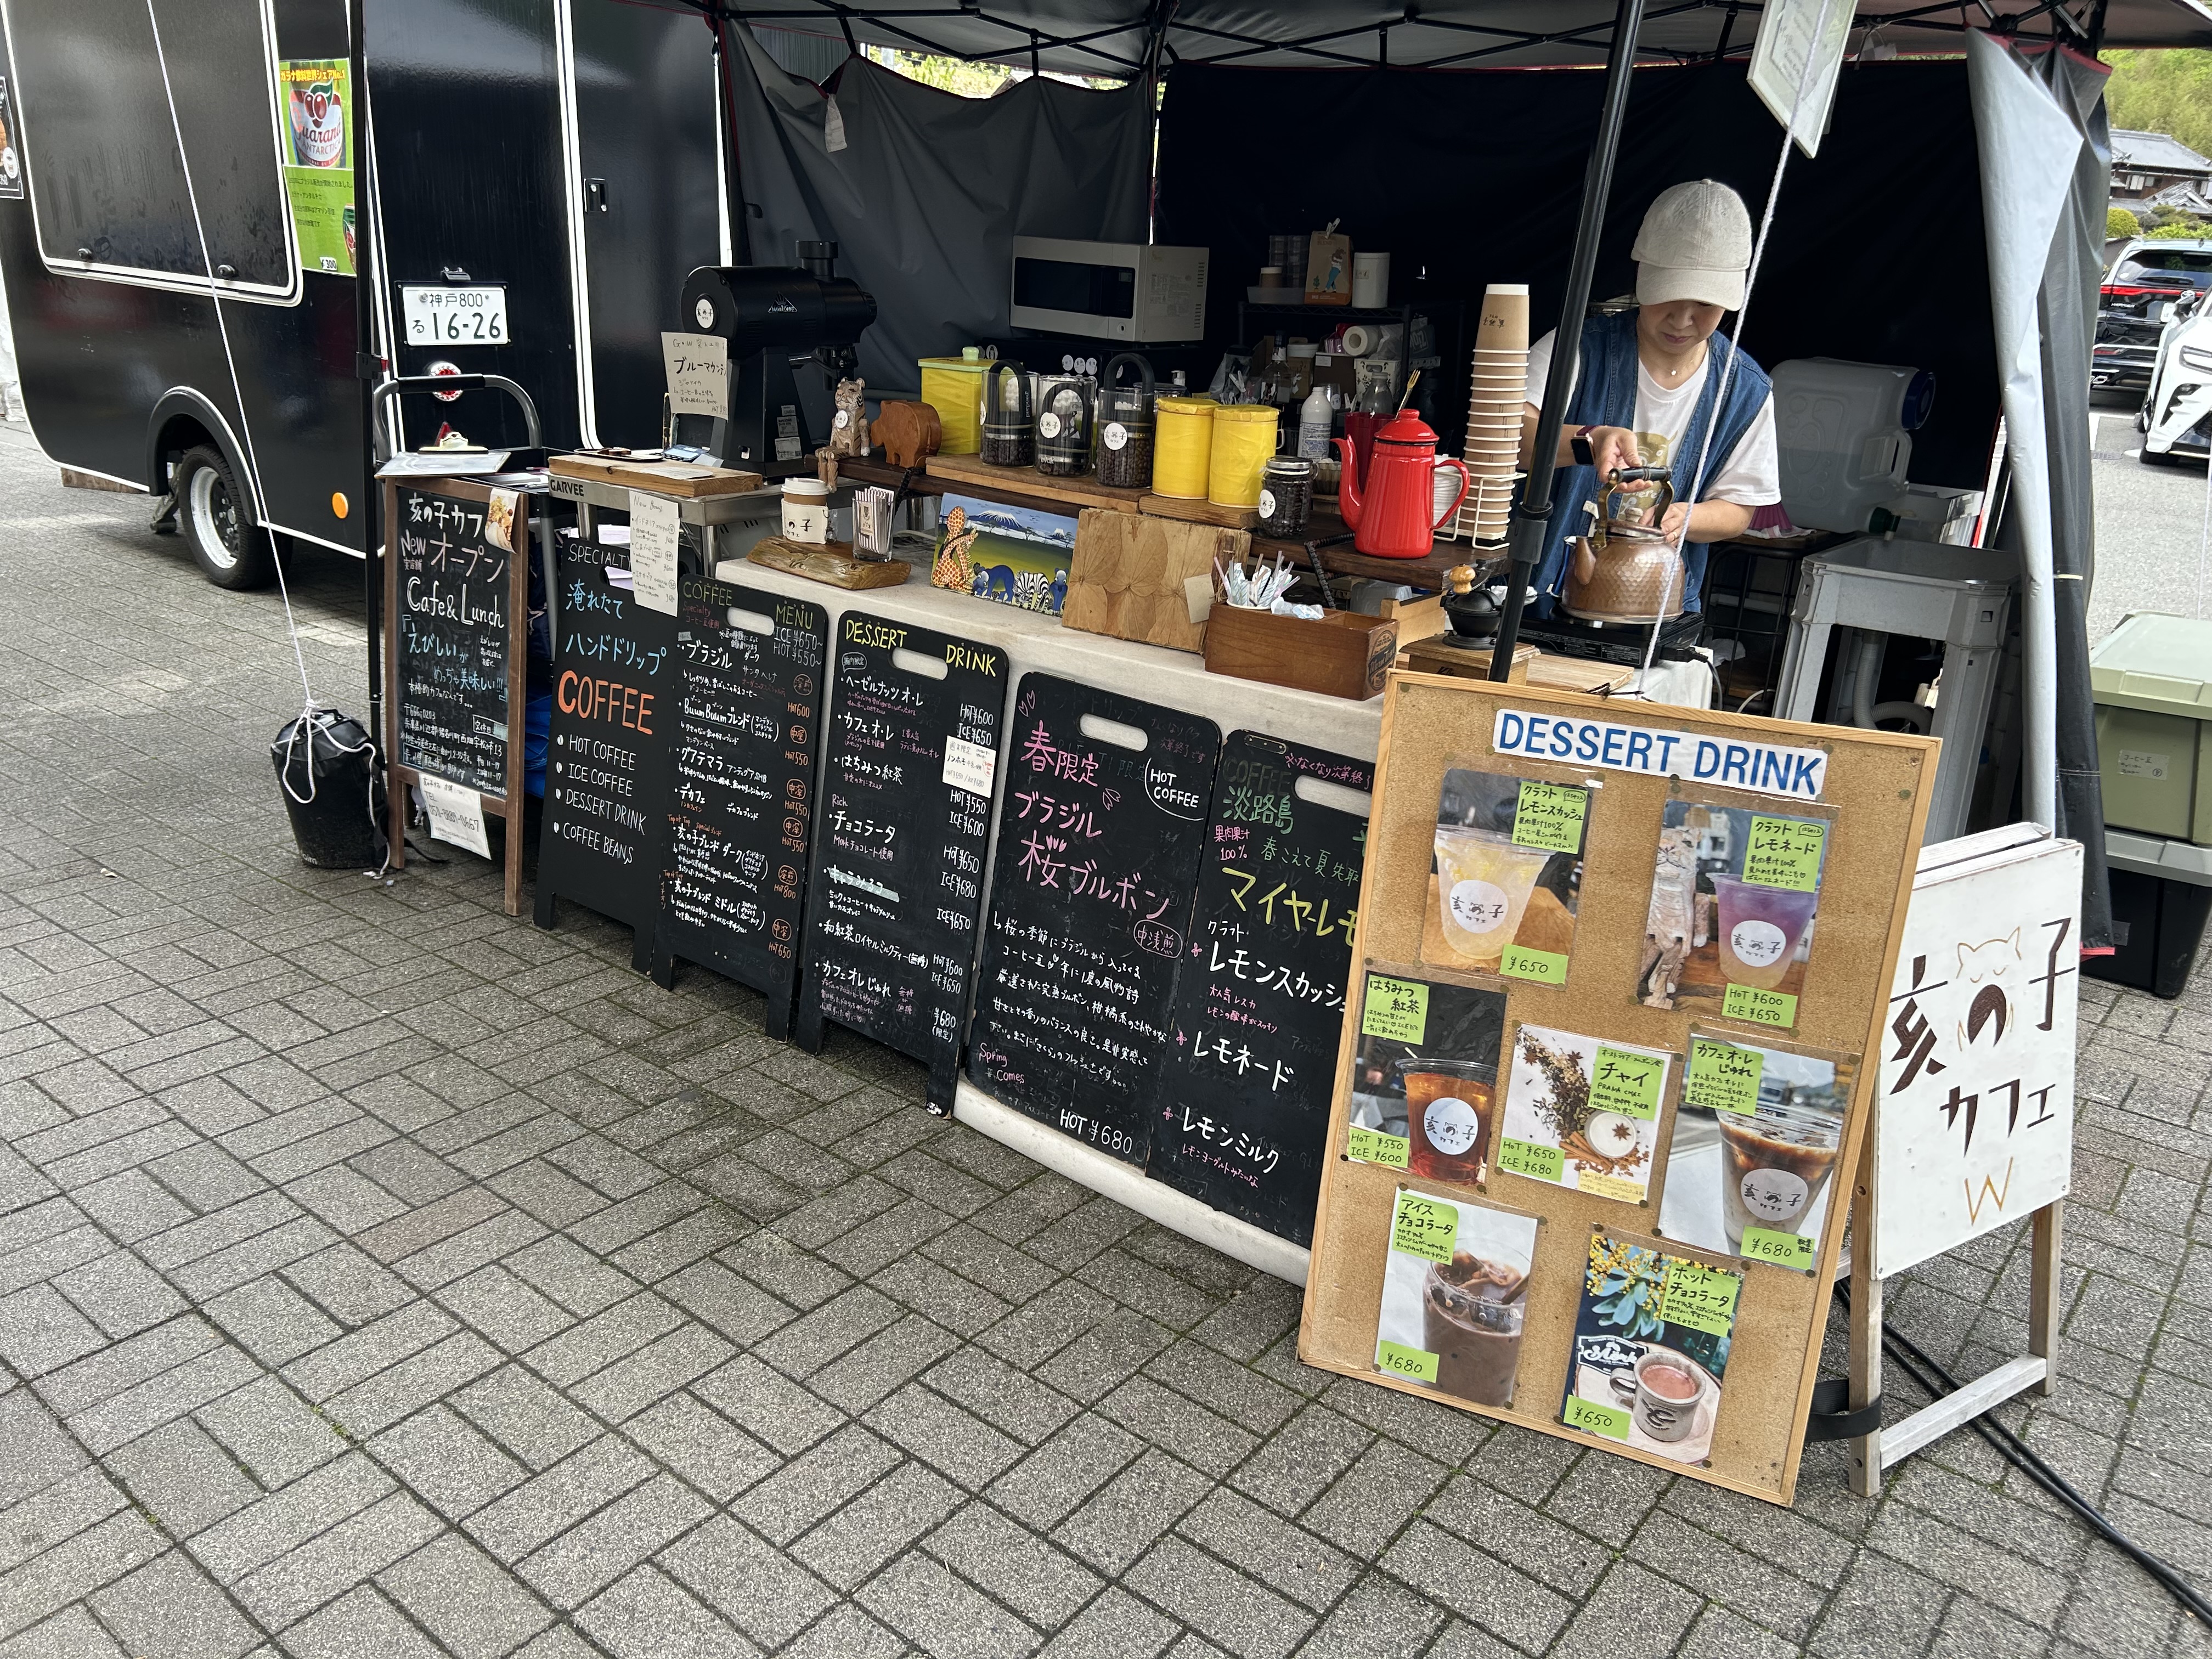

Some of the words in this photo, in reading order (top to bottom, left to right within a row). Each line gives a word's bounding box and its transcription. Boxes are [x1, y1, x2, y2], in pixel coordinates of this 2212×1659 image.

[412, 319, 425, 333] る
[432, 312, 500, 340] 16-26
[550, 479, 584, 497] GARVEE
[400, 529, 426, 557] New
[430, 532, 504, 583] オープン
[568, 543, 631, 571] SPECIALTY
[566, 578, 623, 620] 淹れたて
[682, 601, 711, 617] Specialty
[683, 582, 733, 606] COFFEE
[775, 602, 814, 629] MENU
[773, 626, 792, 644] ICE
[566, 632, 667, 676] ハンドドリップ
[686, 639, 733, 669] ブラジル
[744, 651, 760, 663] ダーク
[772, 642, 791, 658] HOT
[846, 619, 907, 650] DESSERT
[946, 644, 996, 678] DRINK
[557, 669, 655, 735] COFFEE
[568, 733, 591, 755] HOT
[593, 741, 636, 771] COFFEE
[681, 746, 723, 771] グアテマラ
[1019, 719, 1099, 788] 春限定
[1498, 713, 1681, 772] DESSERT
[1693, 741, 1822, 795] DRINK
[568, 763, 589, 783] ICE
[591, 769, 633, 797] COFFEE
[841, 754, 903, 785] はちみつ紅茶
[1149, 768, 1177, 787] HOT
[424, 790, 438, 802] TEL
[680, 782, 706, 804] デカフェ
[832, 794, 848, 808] Rich
[1153, 785, 1200, 809] COFFEE
[1524, 786, 1557, 799] クラフト
[566, 788, 614, 820] DESSERT
[614, 803, 647, 836] DRINK
[1014, 791, 1103, 839] ブラジル
[1222, 785, 1294, 835] 淡路島
[1519, 798, 1584, 821] レモンスカッシュ
[834, 810, 895, 844] チョコラータ
[1213, 824, 1251, 843] 果肉果汁
[1755, 822, 1793, 836] クラフト
[563, 822, 601, 851] COFFEE
[603, 836, 634, 865] BEANS
[677, 822, 720, 853] 亥の子ブレンド
[723, 843, 742, 864] ダーク
[1220, 844, 1248, 861] 100%
[1754, 837, 1817, 855] レモネード
[1018, 829, 1170, 920] 桜ブルボン
[674, 877, 712, 904] 亥の子ブレンド
[714, 895, 736, 913] ミドル
[1207, 920, 1245, 943] クラフト
[1002, 944, 1046, 968] コーヒー豆
[1508, 956, 1549, 974] ¥650
[1209, 984, 1231, 1003] 大人気
[1234, 996, 1257, 1010] レスカ
[1369, 979, 1414, 998] はちみつ
[1752, 992, 1784, 1006] ¥600
[1390, 997, 1420, 1014] 紅茶
[1727, 1004, 1745, 1016] ICE
[1750, 1007, 1781, 1022] ¥650
[1889, 917, 2076, 1096] 亥の子
[933, 1007, 957, 1029] ¥680
[978, 1042, 1008, 1067] Spring
[1194, 1030, 1295, 1092] レモネード
[996, 1069, 1025, 1085] Comes
[1599, 1062, 1650, 1087] チャイ
[1718, 1064, 1754, 1078] じゅれ
[1939, 1078, 2057, 1159] カフェ
[1059, 1108, 1088, 1135] HOT
[1088, 1119, 1133, 1154] ¥680
[1182, 1106, 1279, 1174] レモンミルク
[1351, 1146, 1370, 1158] ICE
[1374, 1150, 1402, 1163] ¥600
[1377, 1137, 1403, 1150] ¥550
[1526, 1145, 1556, 1160] ¥650
[1500, 1155, 1519, 1169] ICE
[1523, 1160, 1552, 1176] ¥680
[1401, 1198, 1434, 1216] アイス
[1398, 1212, 1453, 1235] チョコラータ
[1750, 1238, 1792, 1257] ¥680
[1672, 1267, 1712, 1286] ホット
[1669, 1282, 1730, 1308] チョコラータ
[1386, 1352, 1423, 1374] ¥680
[1573, 1406, 1613, 1427] ¥650
